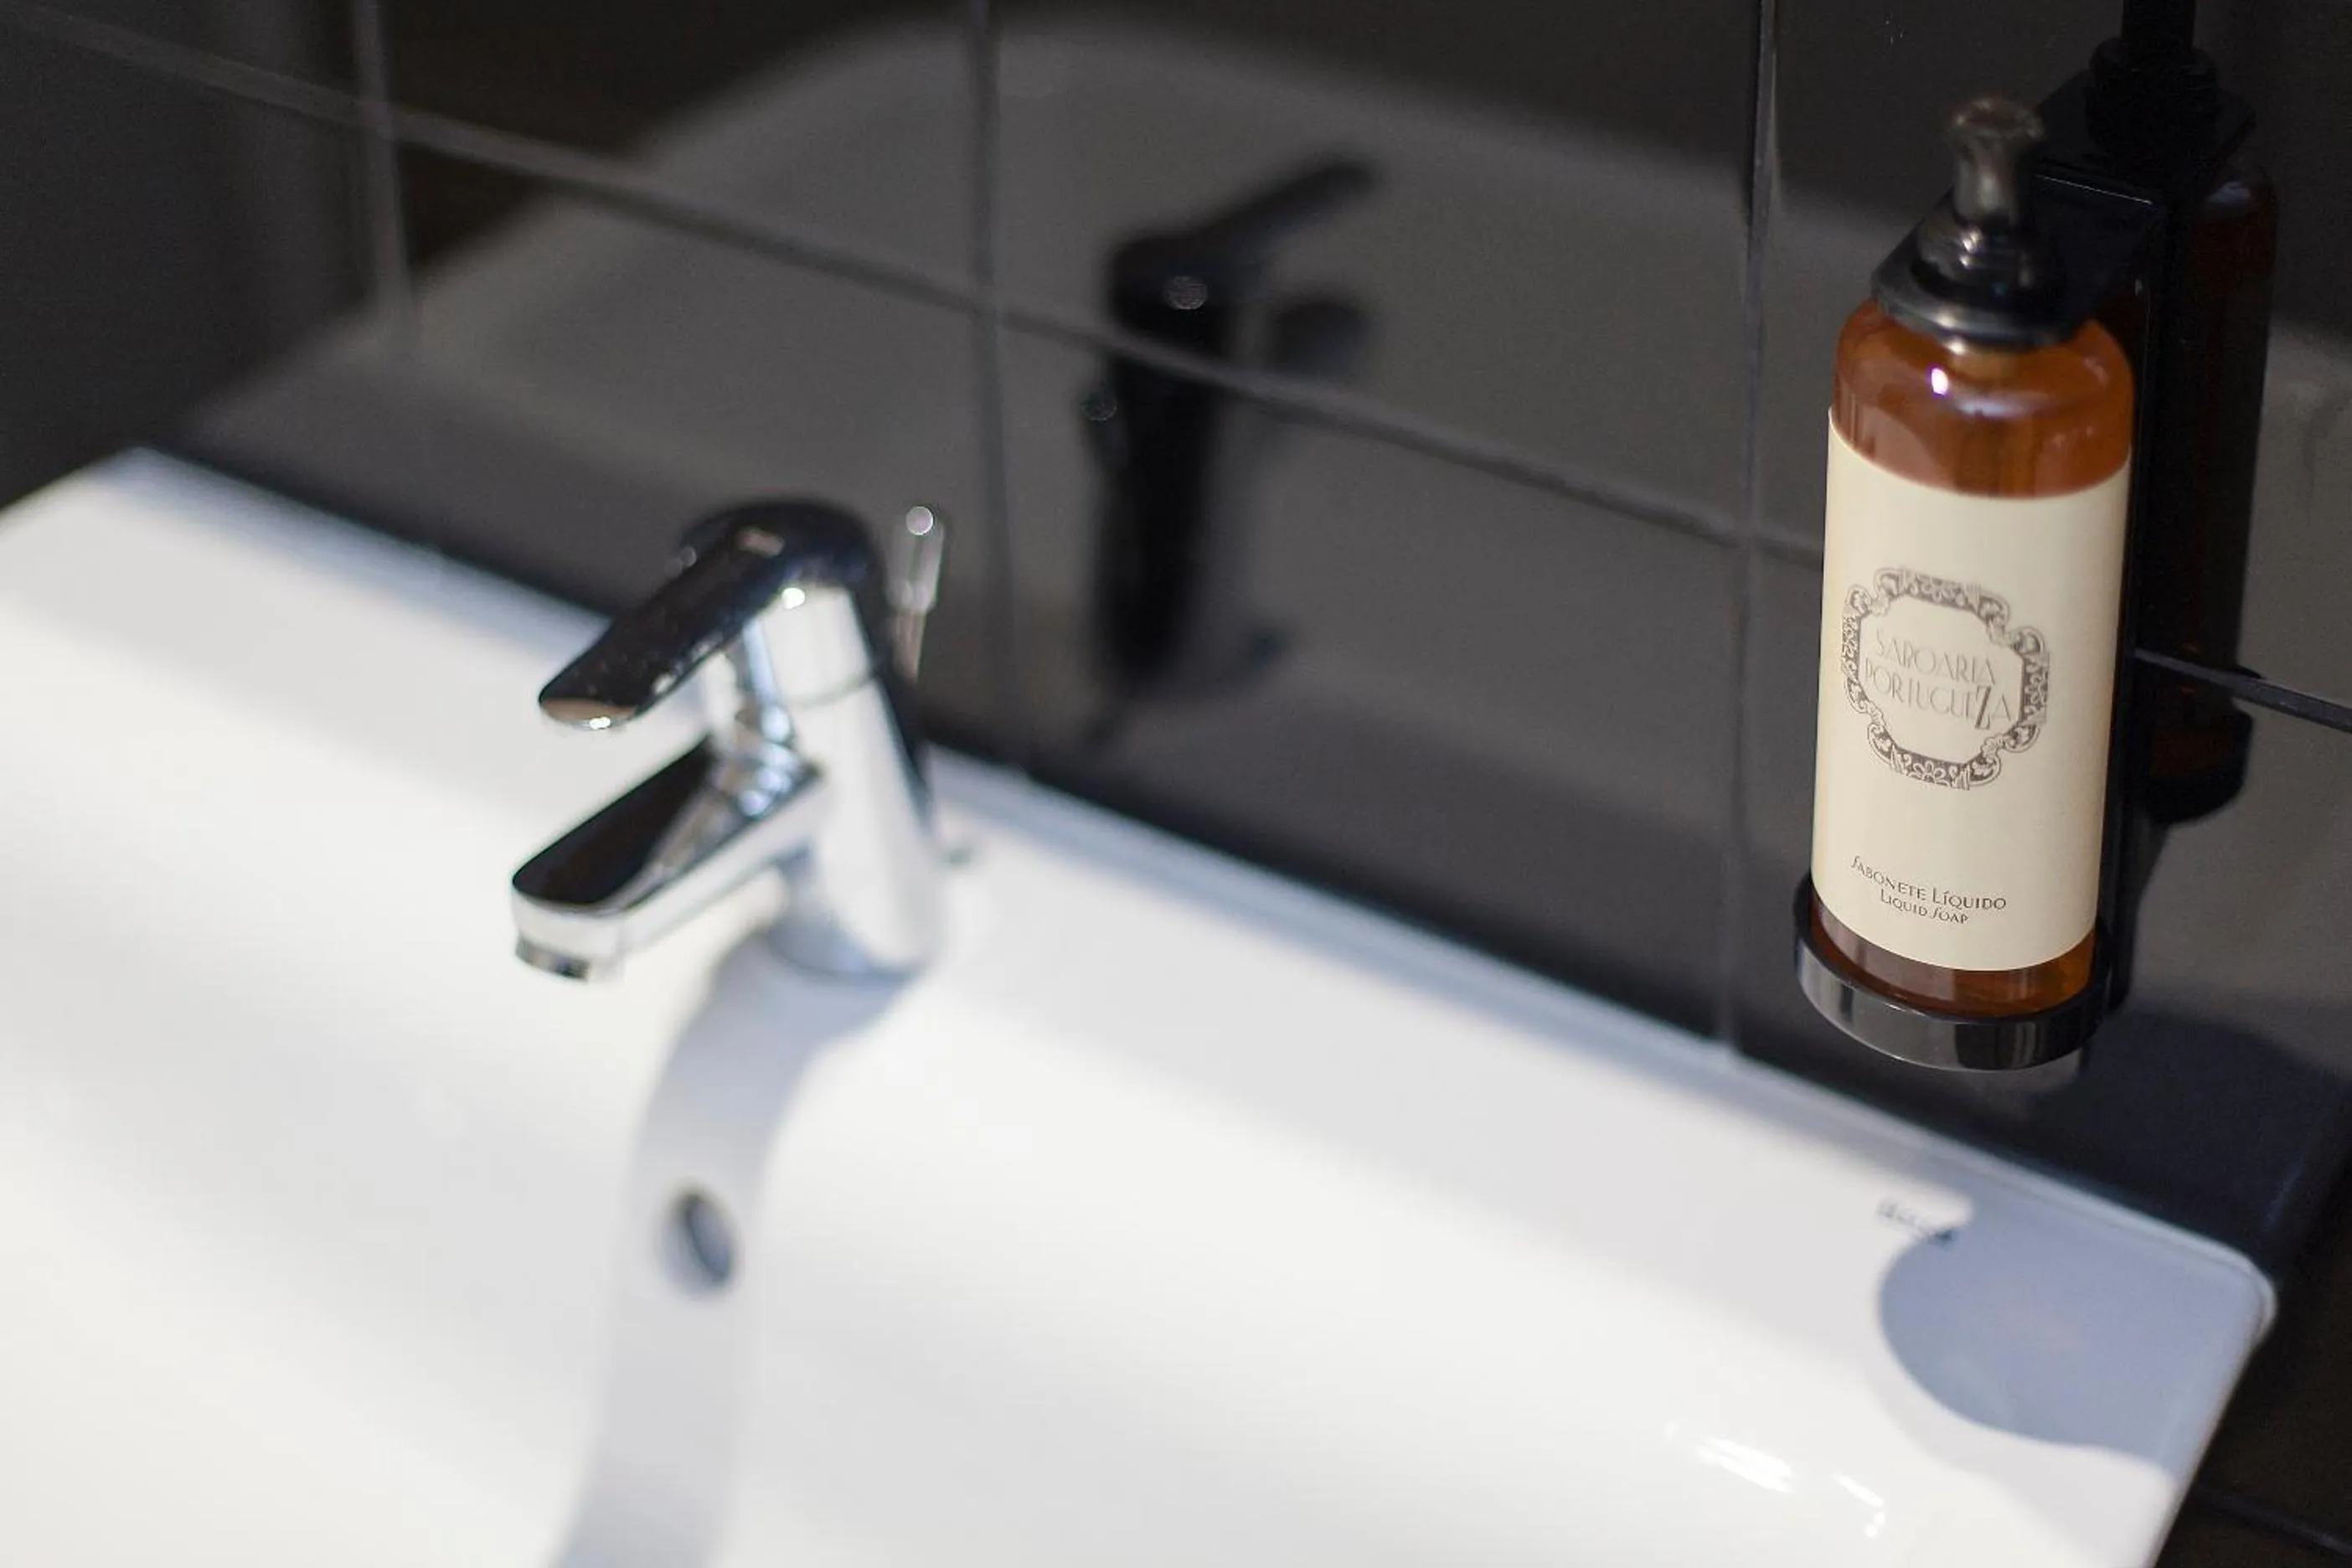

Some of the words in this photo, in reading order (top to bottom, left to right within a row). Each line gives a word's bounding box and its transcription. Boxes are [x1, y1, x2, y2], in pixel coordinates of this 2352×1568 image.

[1874, 627, 1996, 685] SABOARIA
[1850, 854, 1926, 900] SABONETE
[1932, 887, 2007, 910] LÍQUIDO
[1880, 888, 1927, 917] LIQUID
[1930, 905, 1968, 925] SOAP
